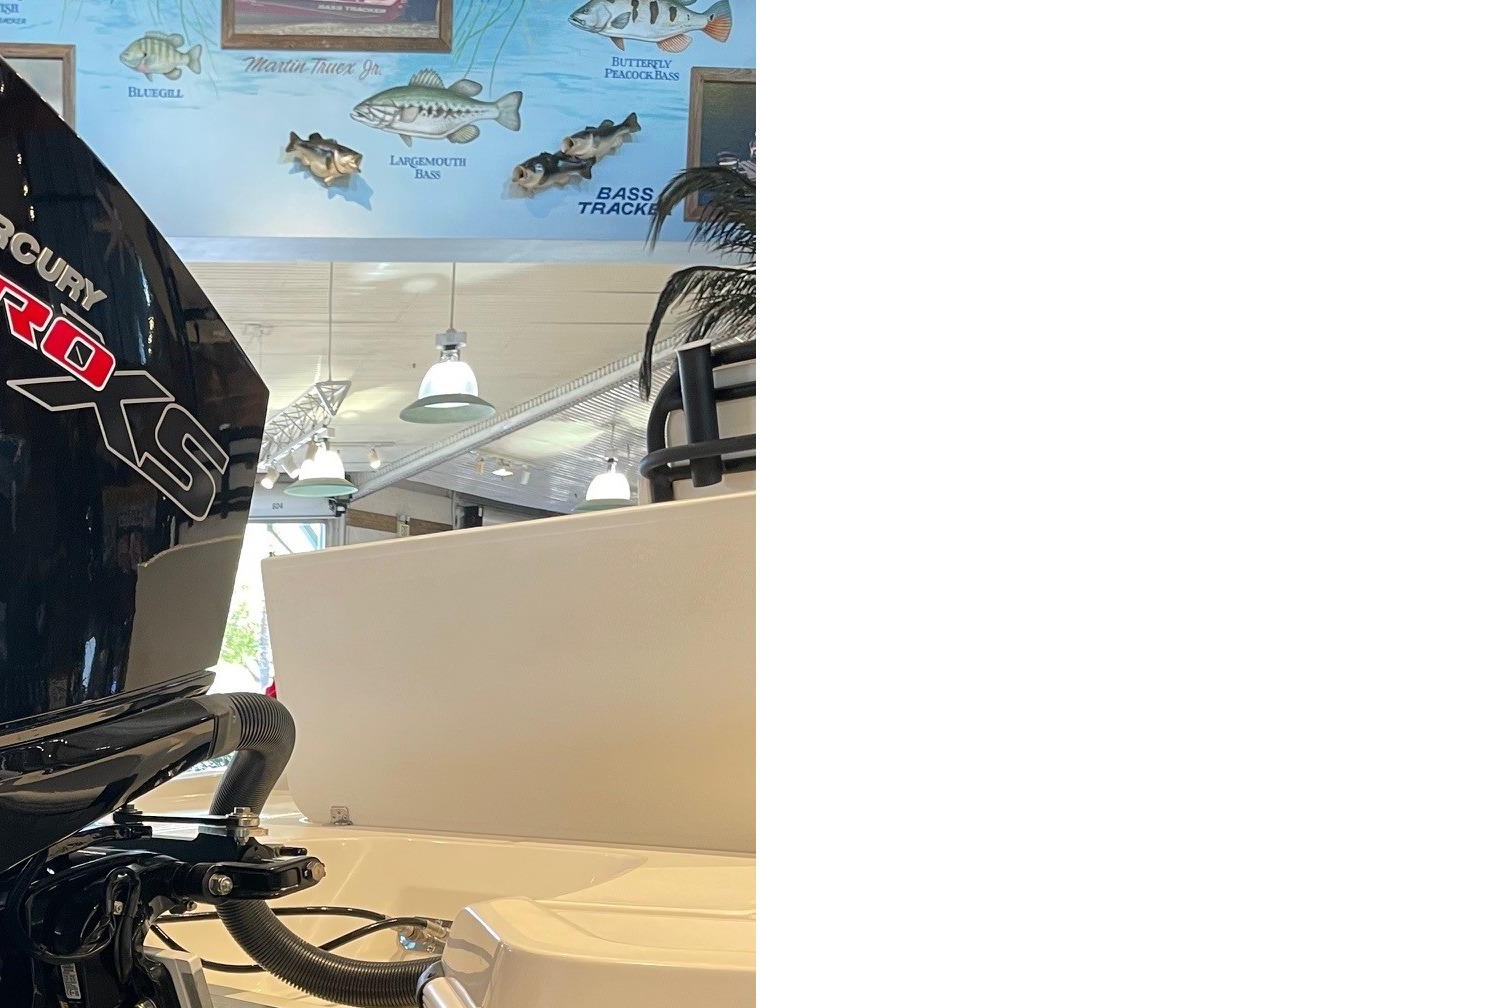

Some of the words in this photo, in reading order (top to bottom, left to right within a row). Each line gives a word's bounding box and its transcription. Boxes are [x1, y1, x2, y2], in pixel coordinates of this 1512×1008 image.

[611, 56, 672, 69] BUTTERFLY
[604, 68, 655, 80] PEACOCK
[655, 70, 680, 81] BASS
[128, 86, 185, 99] BLUEGILL
[390, 155, 467, 168] LARGEMOUTH
[414, 169, 441, 180] BASS
[596, 187, 654, 201] BASS
[578, 201, 672, 216] TRACKE
[6, 303, 230, 521] XS
